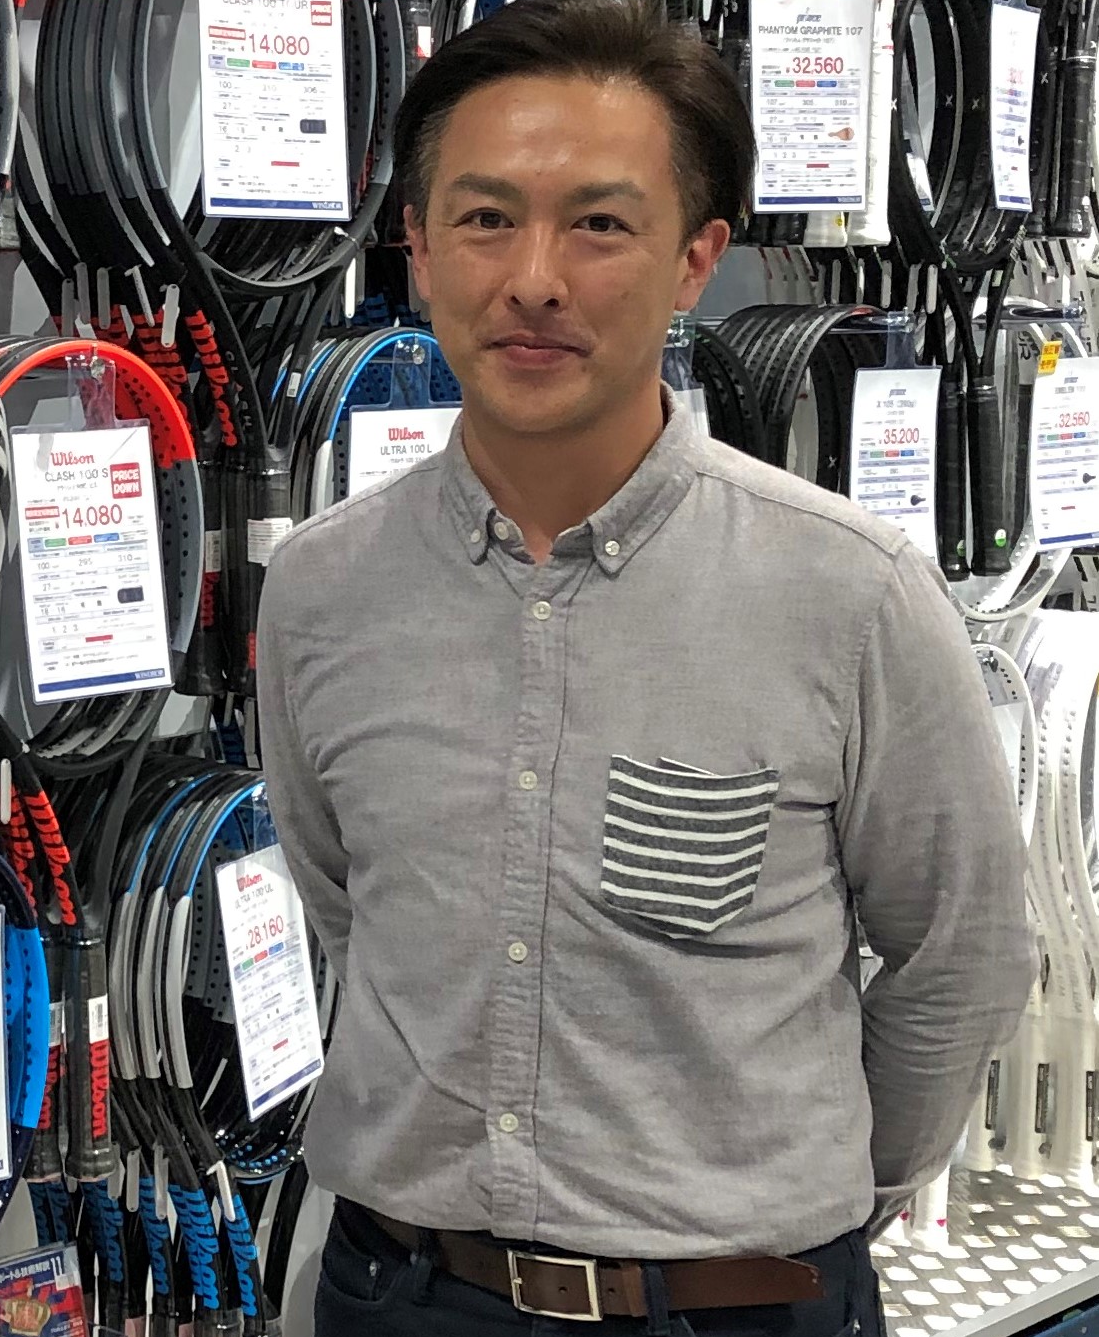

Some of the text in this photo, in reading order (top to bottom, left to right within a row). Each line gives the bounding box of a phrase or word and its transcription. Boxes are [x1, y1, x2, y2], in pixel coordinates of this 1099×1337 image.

[758, 25, 864, 36] PHANTOM GRAPHITE 107
[185, 309, 238, 447] Wilson
[388, 427, 425, 442] Wilson
[380, 444, 433, 456] ULTRA 100 L
[50, 452, 95, 467] Wilson
[45, 468, 109, 482] CLASH 100 S
[112, 468, 140, 481] PRICE
[113, 482, 140, 494] DOWN
[24, 790, 78, 926] Wilson
[236, 873, 263, 893] Wilson
[90, 1040, 111, 1141] Wilson
[187, 1187, 221, 1311] Wilson
